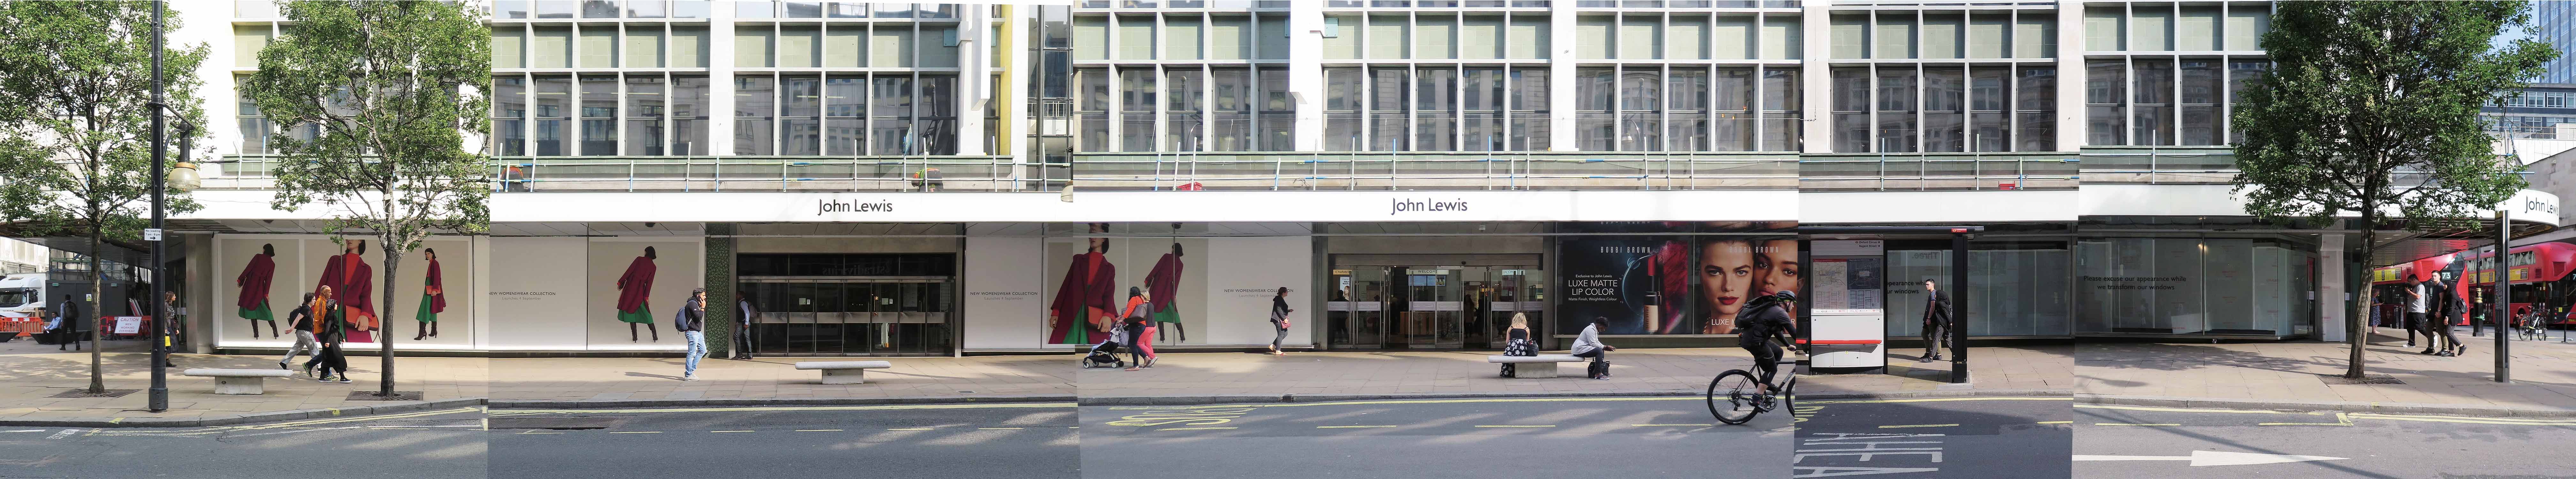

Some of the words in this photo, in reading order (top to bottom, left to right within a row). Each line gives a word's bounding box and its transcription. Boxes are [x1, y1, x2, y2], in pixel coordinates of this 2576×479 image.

[817, 199, 850, 216] John
[855, 199, 892, 212] Lewis
[1391, 197, 1424, 215] John
[1429, 197, 1467, 211] Lewis
[2525, 195, 2545, 214] John
[2547, 199, 2558, 216] Lewis
